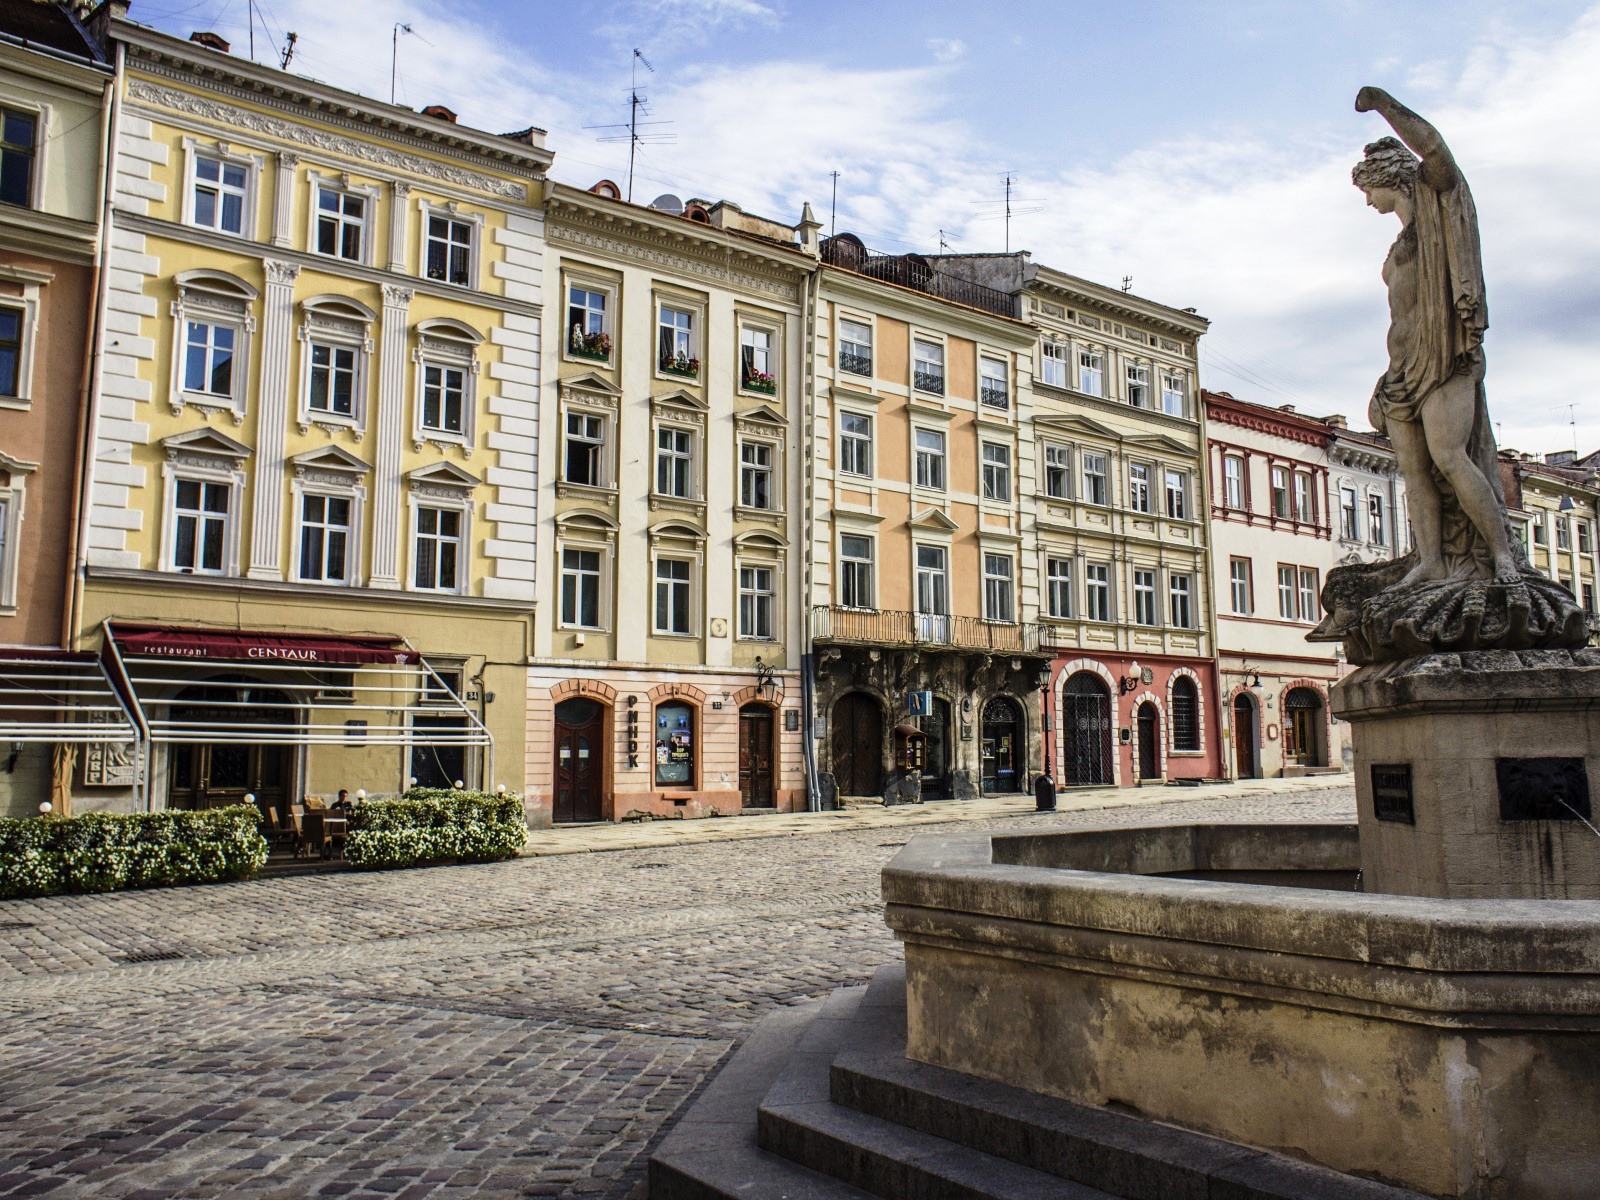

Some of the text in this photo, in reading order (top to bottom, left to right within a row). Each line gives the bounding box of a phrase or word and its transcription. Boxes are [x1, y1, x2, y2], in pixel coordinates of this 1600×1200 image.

[144, 645, 318, 660] restaurant CENTAUR
[468, 691, 477, 700] 34
[627, 694, 638, 768] РИНОК
